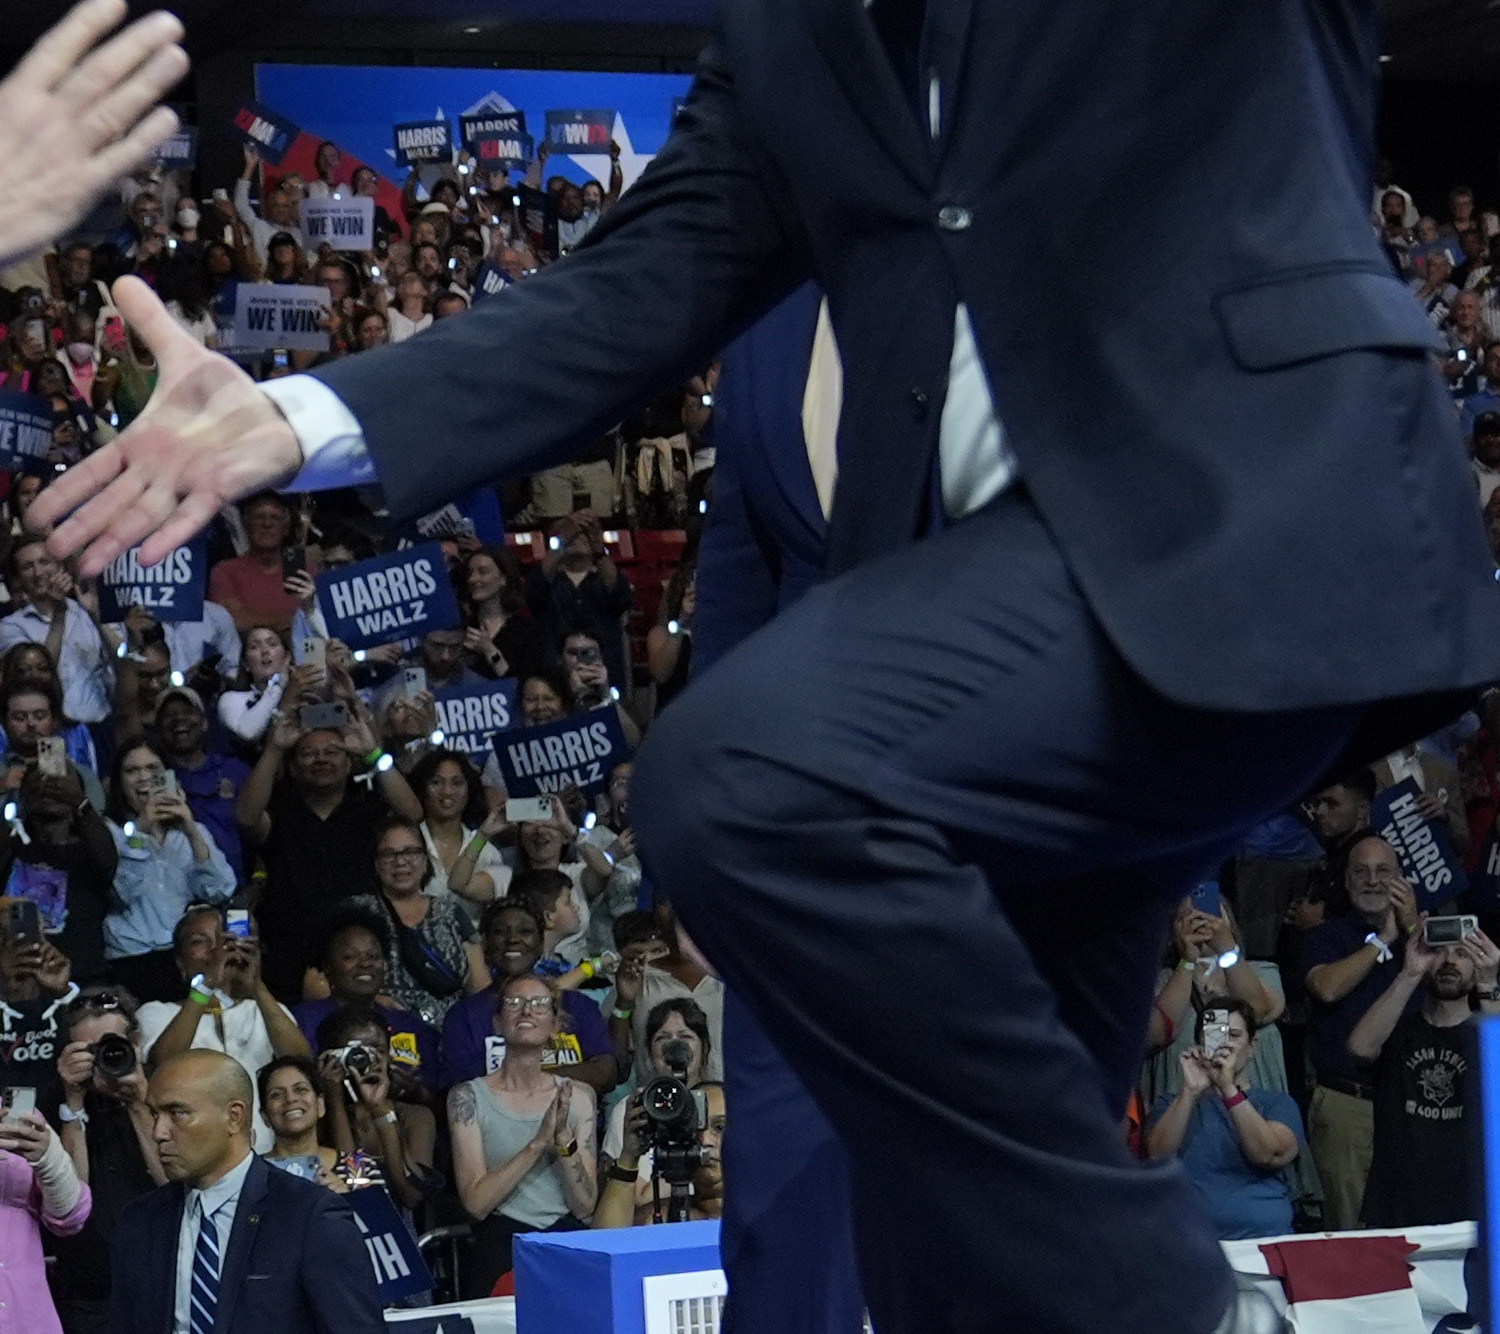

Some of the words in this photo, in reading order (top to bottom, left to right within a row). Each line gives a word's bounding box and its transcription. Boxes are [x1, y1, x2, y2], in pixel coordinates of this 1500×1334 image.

[397, 126, 447, 149] HARRIS
[406, 146, 440, 160] WALZ
[307, 216, 329, 236] WE
[332, 214, 364, 236] WIN
[247, 307, 275, 332] WE
[280, 304, 322, 333] WIN
[114, 585, 175, 608] WALZ
[330, 559, 438, 619] HARRIS
[356, 600, 428, 638] WALZ
[432, 690, 511, 731] ARRIS
[507, 720, 613, 778] HARRIS
[534, 761, 605, 799] WALZ
[1388, 792, 1453, 893] HARRIS
[1405, 1047, 1437, 1071] JASON
[1416, 1104, 1439, 1120] 400
